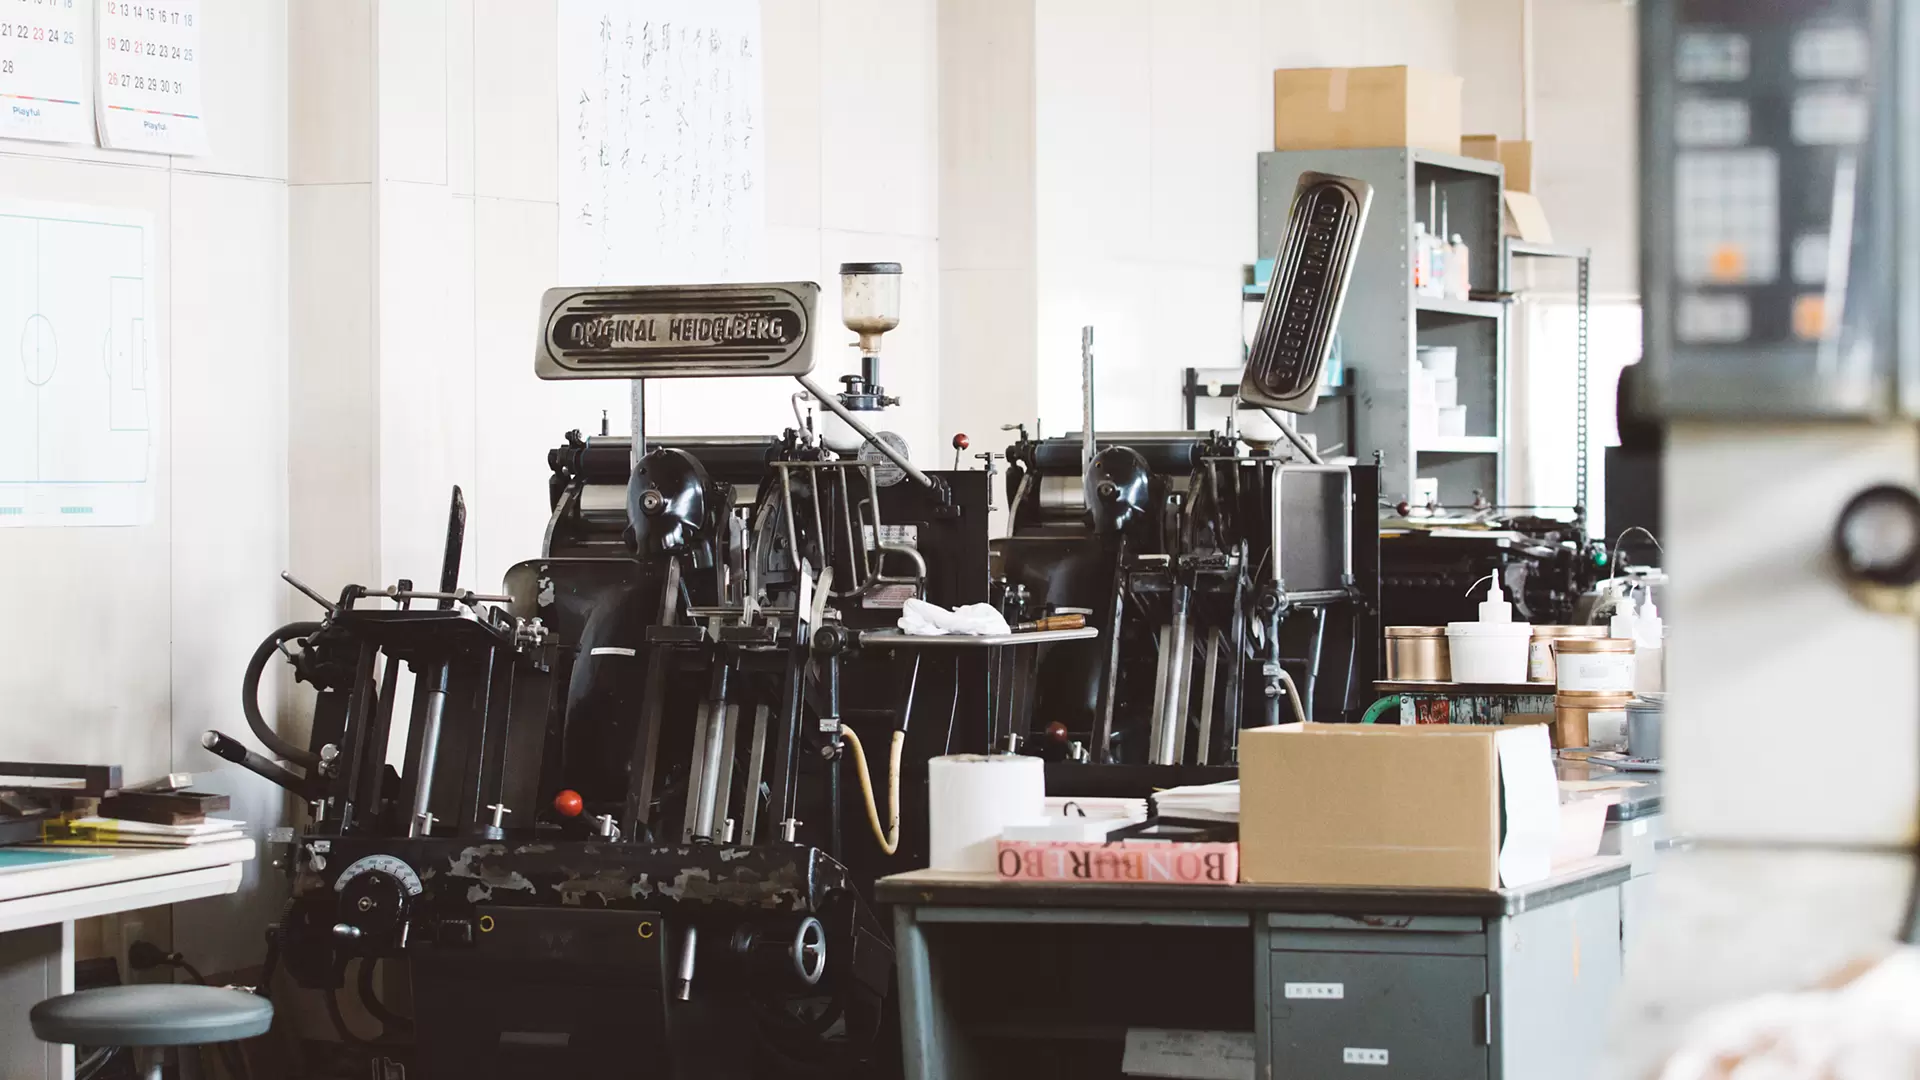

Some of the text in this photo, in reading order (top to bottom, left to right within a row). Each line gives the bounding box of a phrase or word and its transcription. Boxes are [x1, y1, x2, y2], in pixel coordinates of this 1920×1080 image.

[108, 2, 192, 26] 12 13 14 15 16 17 18
[2, 24, 73, 44] 21 22 23 24 25
[108, 38, 192, 61] 19 20 21 22 23 24 25
[3, 60, 13, 73] 28
[108, 73, 181, 93] 26 27 28 29 30 31
[13, 106, 40, 117] Playful
[144, 121, 166, 130] Playful
[571, 316, 784, 345] ORIGINAL HEIDELBERG
